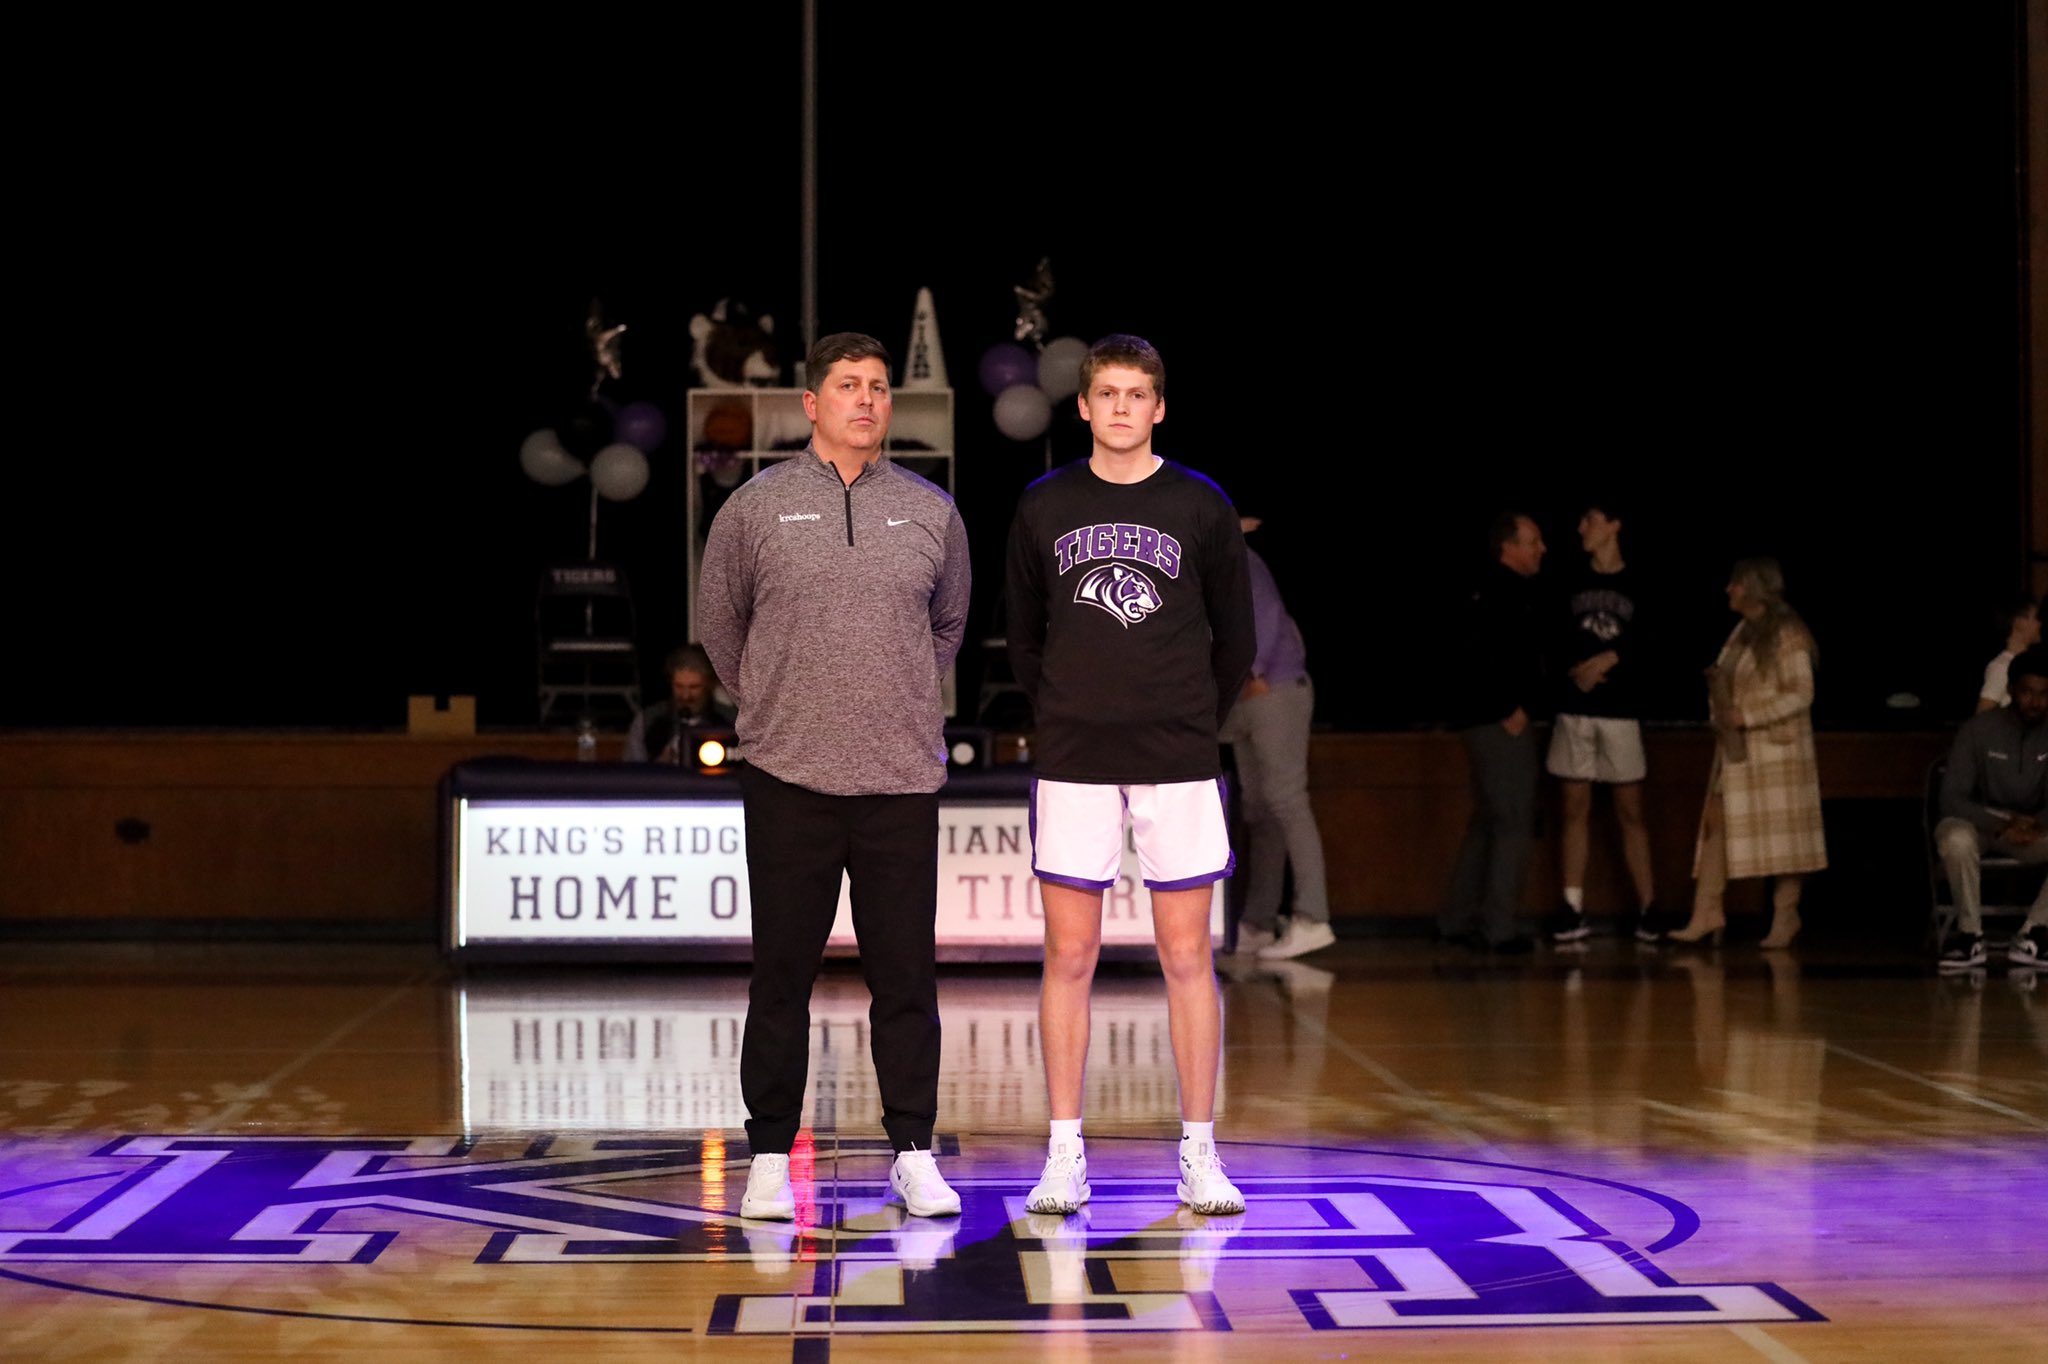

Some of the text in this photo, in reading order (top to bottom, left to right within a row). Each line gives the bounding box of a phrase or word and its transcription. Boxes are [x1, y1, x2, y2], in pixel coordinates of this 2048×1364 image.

[1055, 523, 1182, 580] TIGERS
[486, 826, 624, 855] KING'S
[645, 826, 740, 855] RIDG
[510, 875, 678, 920] HOME
[709, 875, 738, 920] O
